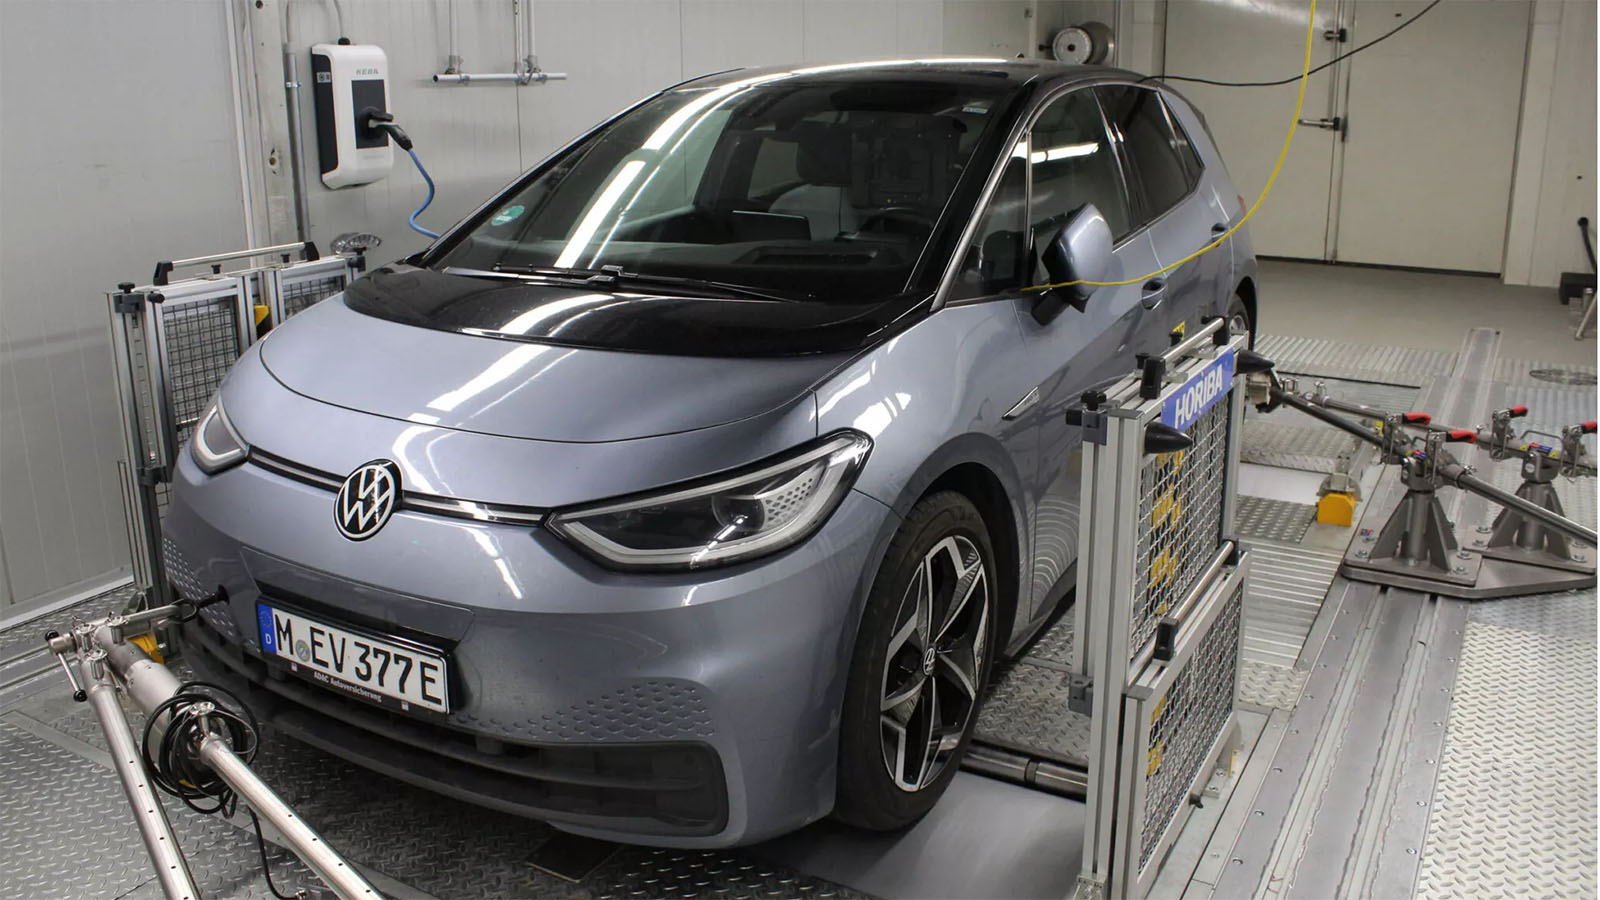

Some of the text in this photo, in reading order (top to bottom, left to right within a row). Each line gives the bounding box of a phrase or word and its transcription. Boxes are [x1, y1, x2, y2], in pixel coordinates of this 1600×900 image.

[356, 67, 379, 76] KEBA
[1174, 364, 1223, 430] HORIBA
[265, 633, 272, 645] D
[274, 613, 443, 706] M EV 377E
[313, 671, 329, 684] ADAC
